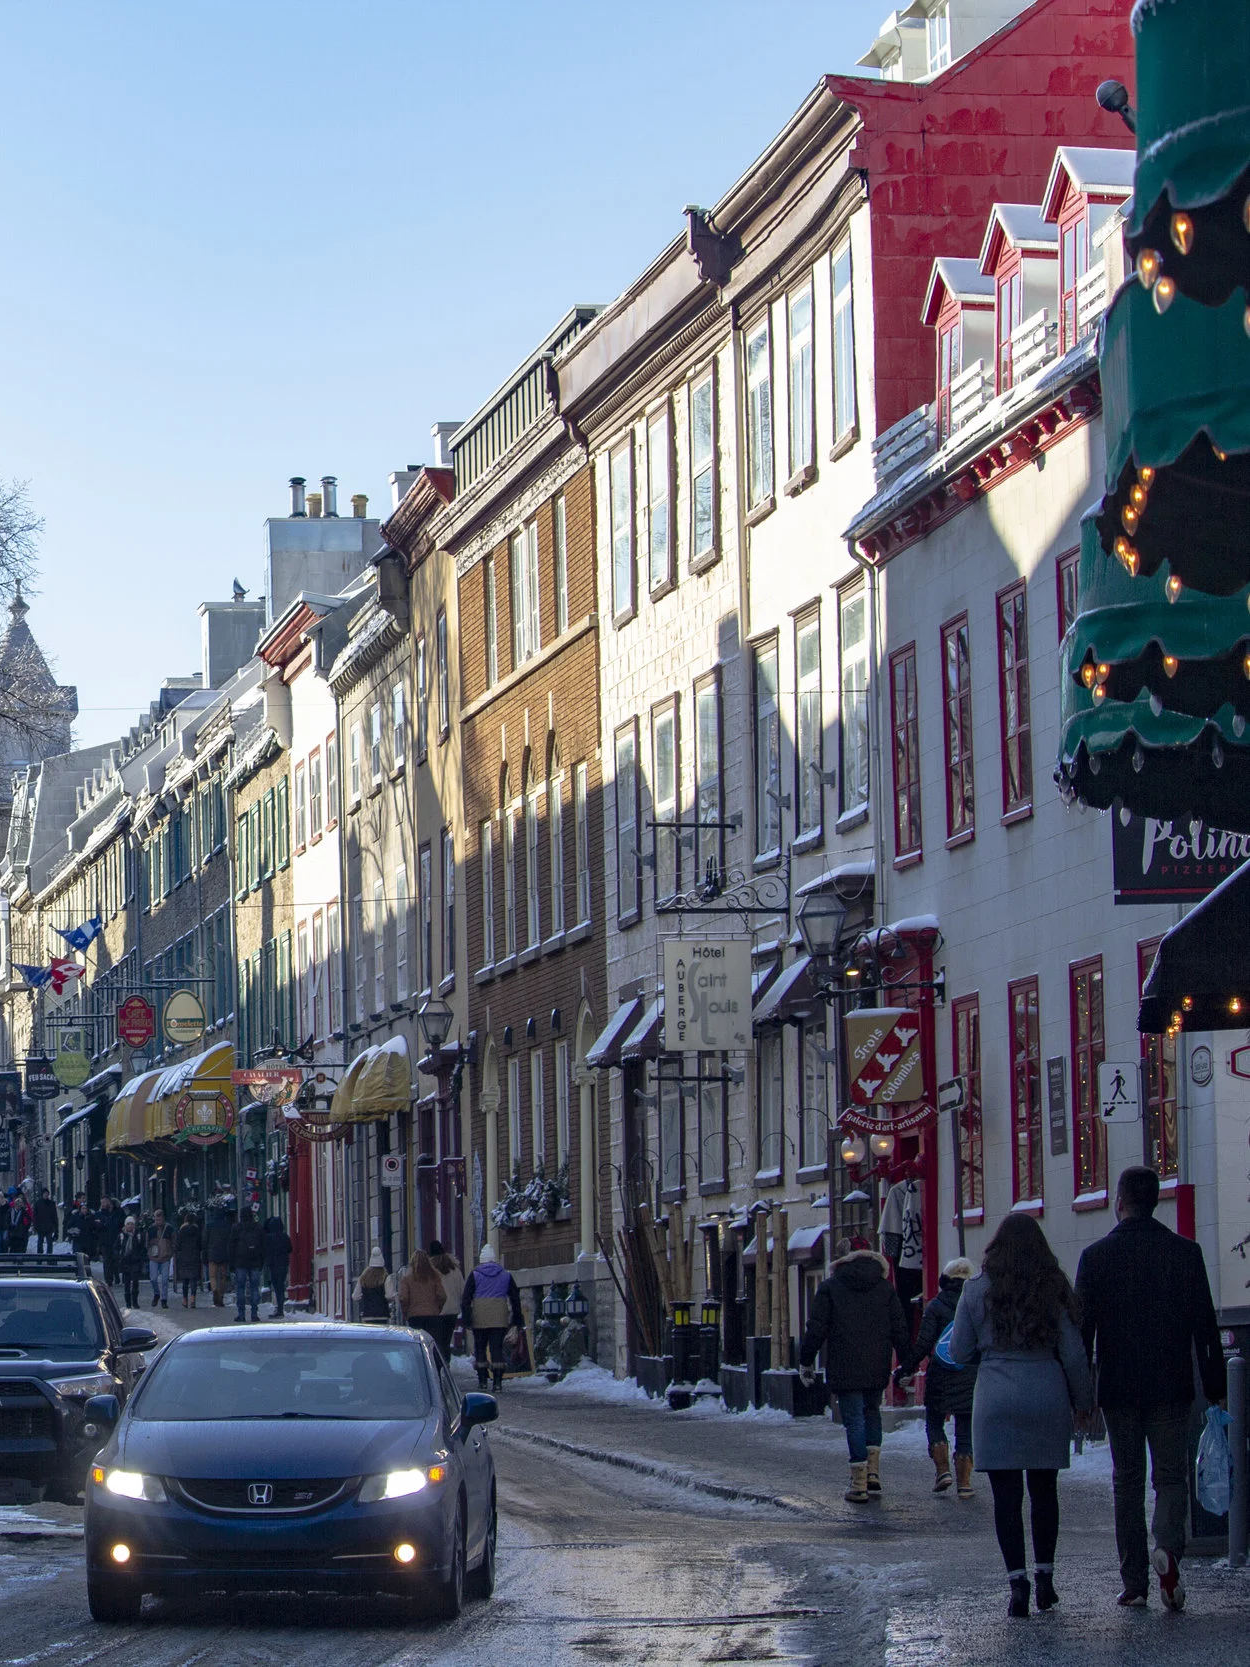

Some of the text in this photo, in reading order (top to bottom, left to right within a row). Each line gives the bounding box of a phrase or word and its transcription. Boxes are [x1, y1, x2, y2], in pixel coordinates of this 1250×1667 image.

[1161, 865, 1236, 875] PIZZERI
[692, 946, 725, 958] Hôtel
[676, 958, 687, 1041] AUBERGE
[687, 960, 727, 1022] Saint
[700, 991, 739, 1045] Louis
[854, 1028, 884, 1059] Trois
[881, 1051, 920, 1101] Colombes
[844, 1113, 874, 1130] galerie
